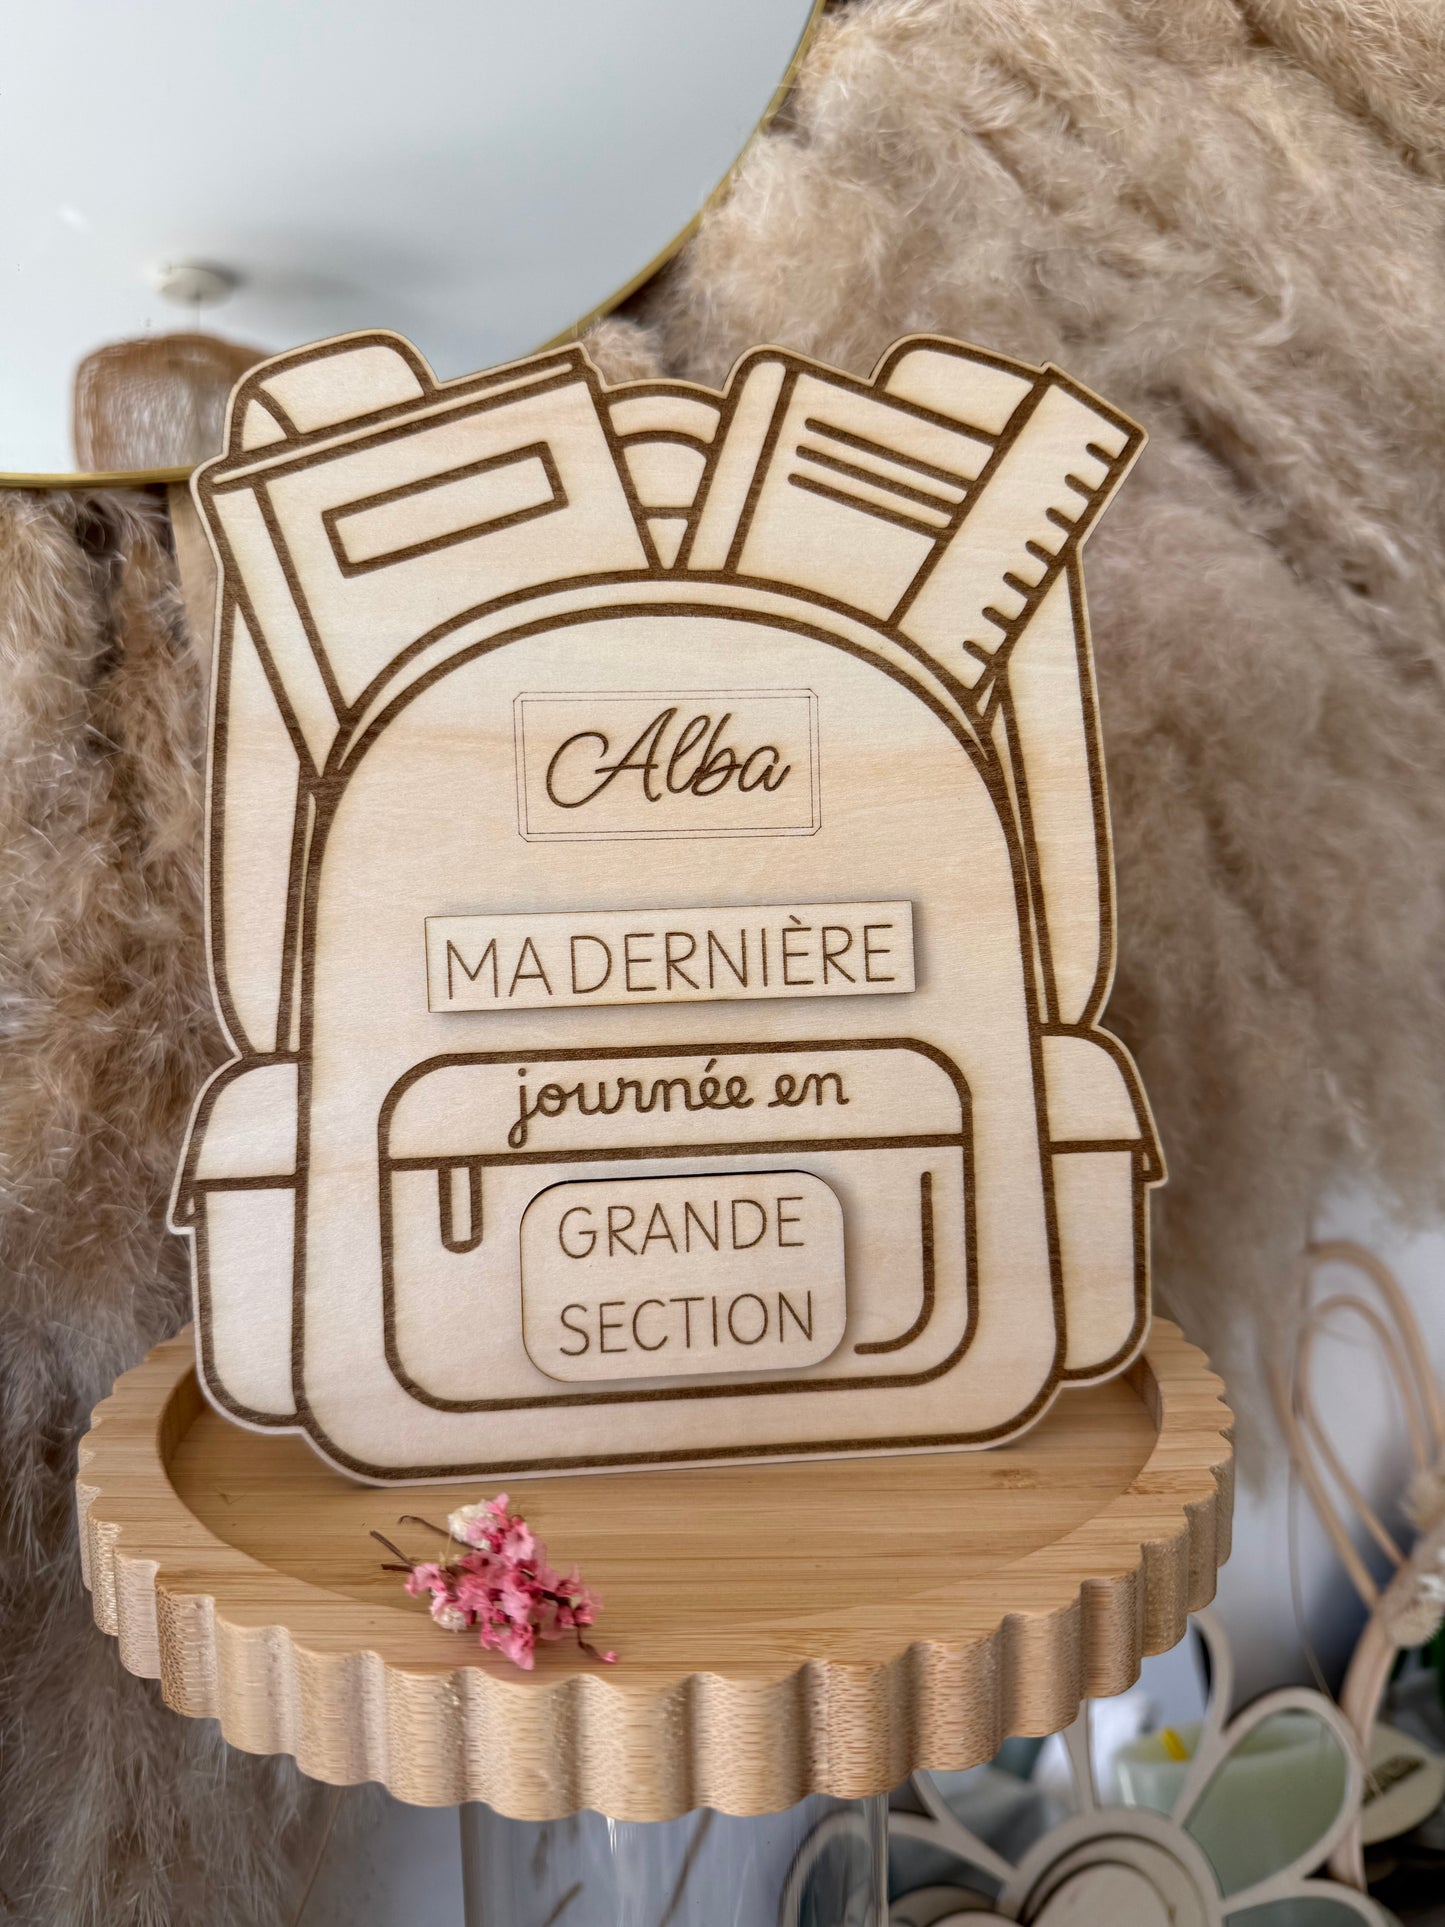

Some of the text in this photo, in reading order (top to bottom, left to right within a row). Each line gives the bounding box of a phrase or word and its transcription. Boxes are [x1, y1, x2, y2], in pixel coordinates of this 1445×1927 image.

[546, 707, 791, 809] Alba
[446, 914, 896, 1000] MA DERNIÈRE
[507, 1058, 850, 1148] journée en
[558, 1196, 805, 1259] GRANDE
[559, 1290, 813, 1356] SECTION
